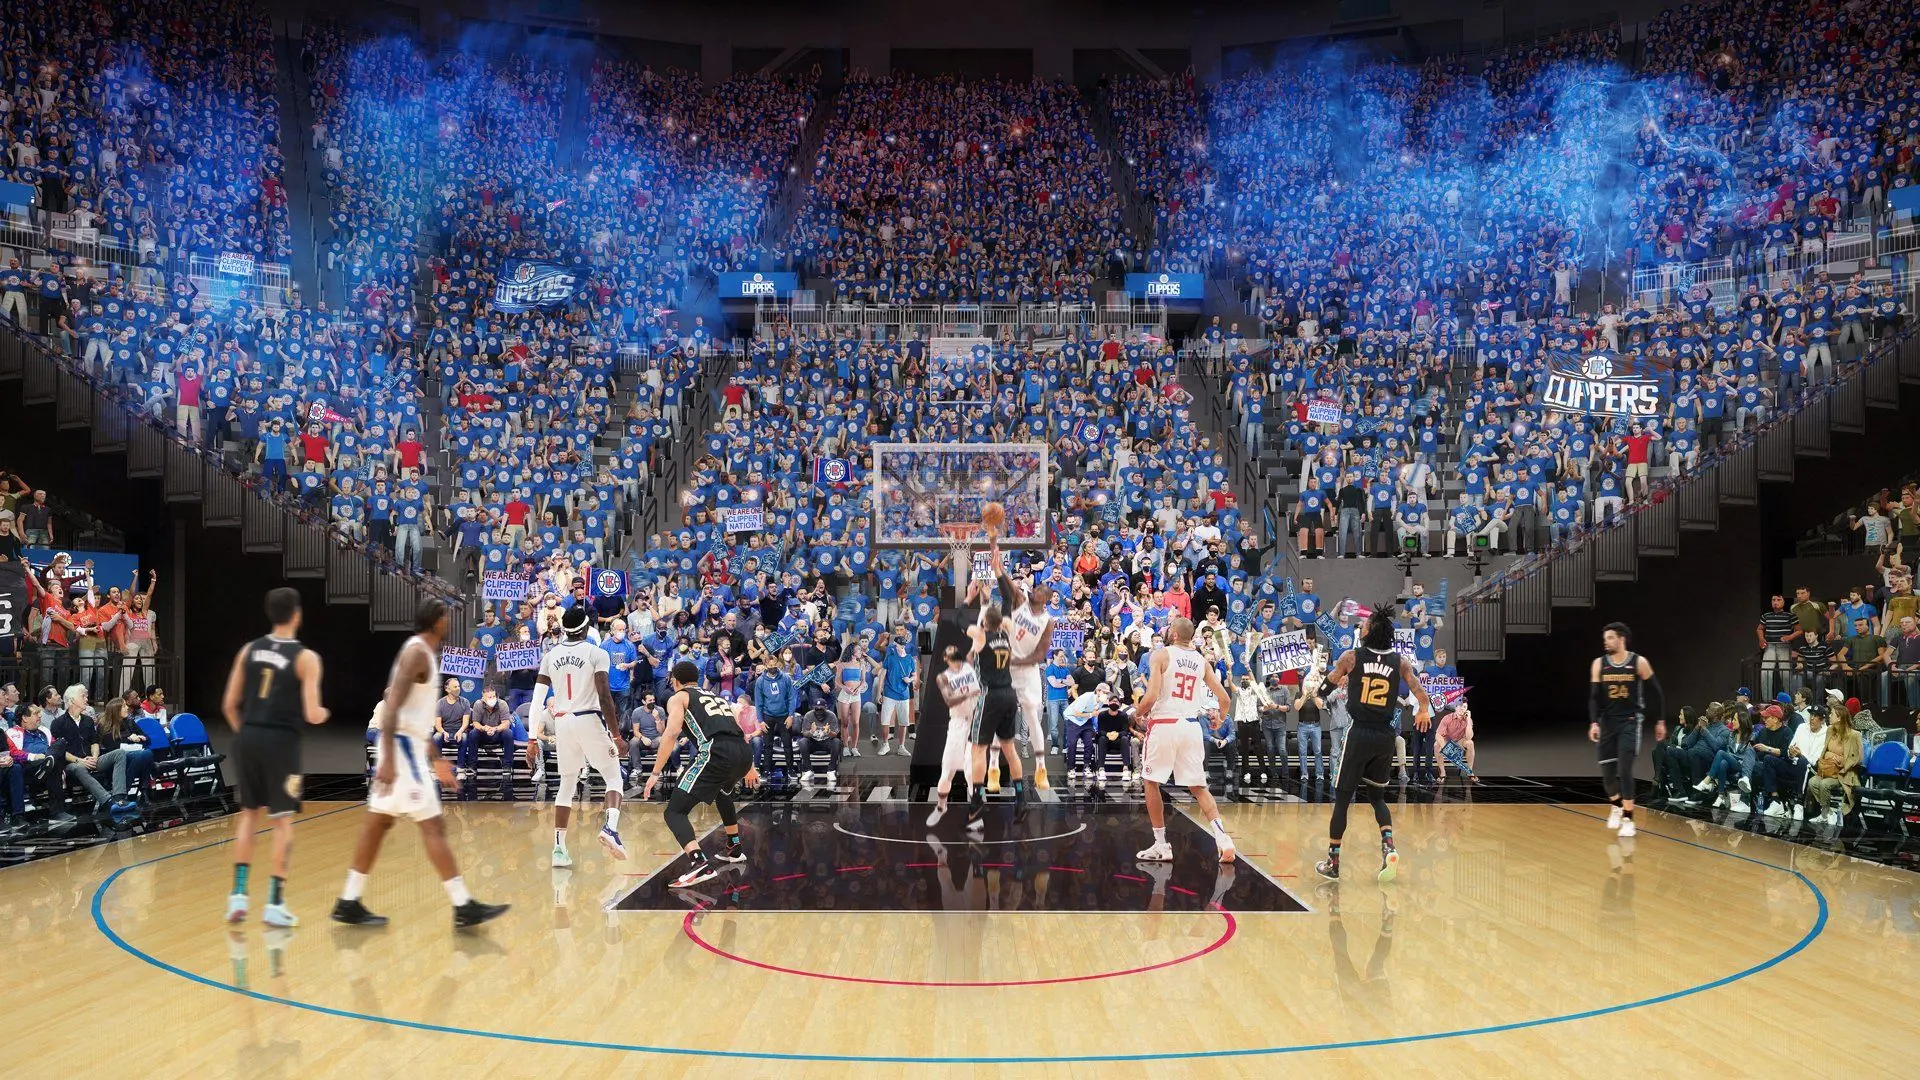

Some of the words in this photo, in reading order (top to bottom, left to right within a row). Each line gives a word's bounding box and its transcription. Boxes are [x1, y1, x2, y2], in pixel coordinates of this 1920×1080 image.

[222, 257, 249, 267] CLIPPER
[221, 264, 247, 273] NATION
[742, 282, 775, 294] CLIPPERS
[1148, 283, 1180, 295] CLIPPERS
[1543, 374, 1659, 415] CLIPPERS
[1310, 406, 1337, 416] CLIPPER
[1310, 412, 1335, 422] NATION
[728, 514, 758, 523] CLIPPER
[729, 521, 757, 530] NATION
[485, 571, 497, 580] WE
[497, 572, 514, 581] ARE
[514, 572, 530, 581] ONE
[485, 579, 522, 590] CLIPPER
[486, 588, 520, 598] NATION
[1053, 622, 1069, 631] ARE
[1070, 621, 1085, 631] ONE
[1016, 628, 1026, 642] 9
[1052, 631, 1078, 640] IPPER
[1262, 637, 1284, 649] THIS
[1285, 634, 1297, 645] IS
[1299, 633, 1305, 643] A
[1406, 631, 1413, 641] A
[496, 643, 510, 652] WE
[509, 641, 525, 651] ARE
[525, 640, 540, 649] ONE
[1050, 639, 1076, 648] ATION
[443, 647, 455, 655] WE
[456, 649, 472, 657] ARE
[472, 650, 488, 659] ONE
[498, 649, 536, 661] CLIPPER
[994, 648, 1010, 669] 17
[1261, 642, 1310, 665] CLIPPERS
[443, 655, 480, 668] CLIPPER
[500, 658, 534, 670] NATION
[553, 655, 586, 671] JACKSON
[1176, 657, 1199, 672] BATUM
[1264, 660, 1288, 673] TOWN
[443, 663, 477, 675] NATION
[1363, 661, 1394, 678] MORANT
[566, 673, 572, 700] 1
[1171, 671, 1197, 702] 33
[1420, 677, 1431, 685] WE
[1432, 677, 1448, 685] ARE
[1449, 676, 1464, 686] ONE
[1360, 676, 1390, 706] 12
[1607, 684, 1629, 699] 24
[698, 695, 735, 717] 22
